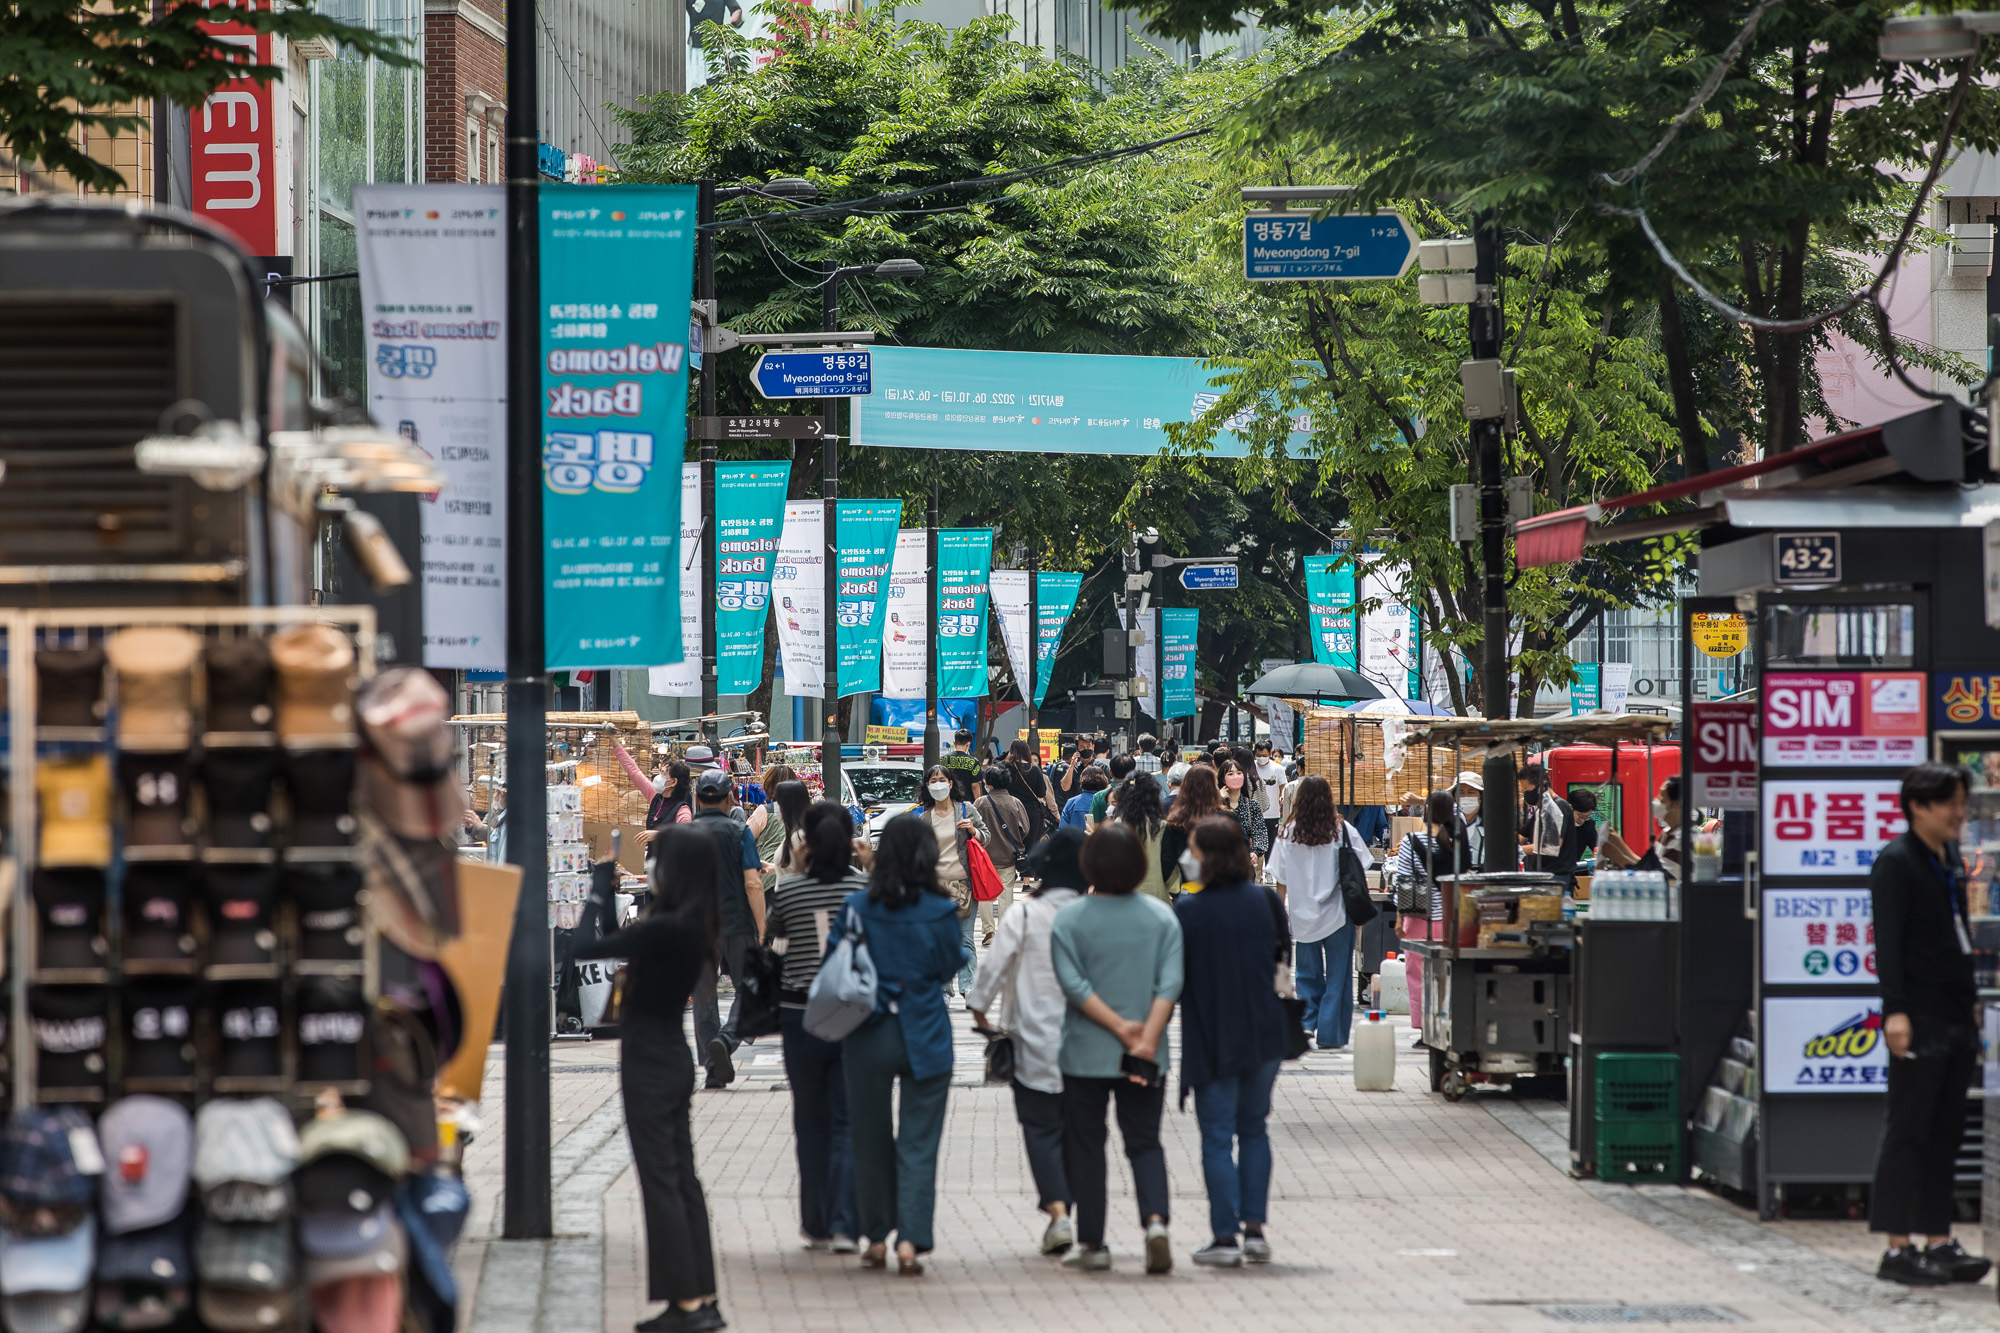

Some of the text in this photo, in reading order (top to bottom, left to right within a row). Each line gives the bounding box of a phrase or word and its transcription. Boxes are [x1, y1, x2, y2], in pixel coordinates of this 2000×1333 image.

[1253, 221, 1311, 241] 명동7길
[1385, 228, 1399, 237] 26
[1254, 246, 1360, 259] Myeongdong 7-gil
[823, 354, 868, 370] 명동8길
[783, 372, 868, 384] Myeongdong 8-gil
[1781, 547, 1834, 569] 43-2
[1213, 568, 1236, 576] 명동4길
[1309, 604, 1352, 615] Welco
[1322, 617, 1352, 628] Back
[1628, 678, 1708, 696] OTTE
[1768, 688, 1852, 729] SIM
[882, 727, 907, 735] HELLO
[1699, 722, 1758, 764] SIM
[1801, 850, 1836, 866] 사고
[1774, 898, 1838, 918] BEST
